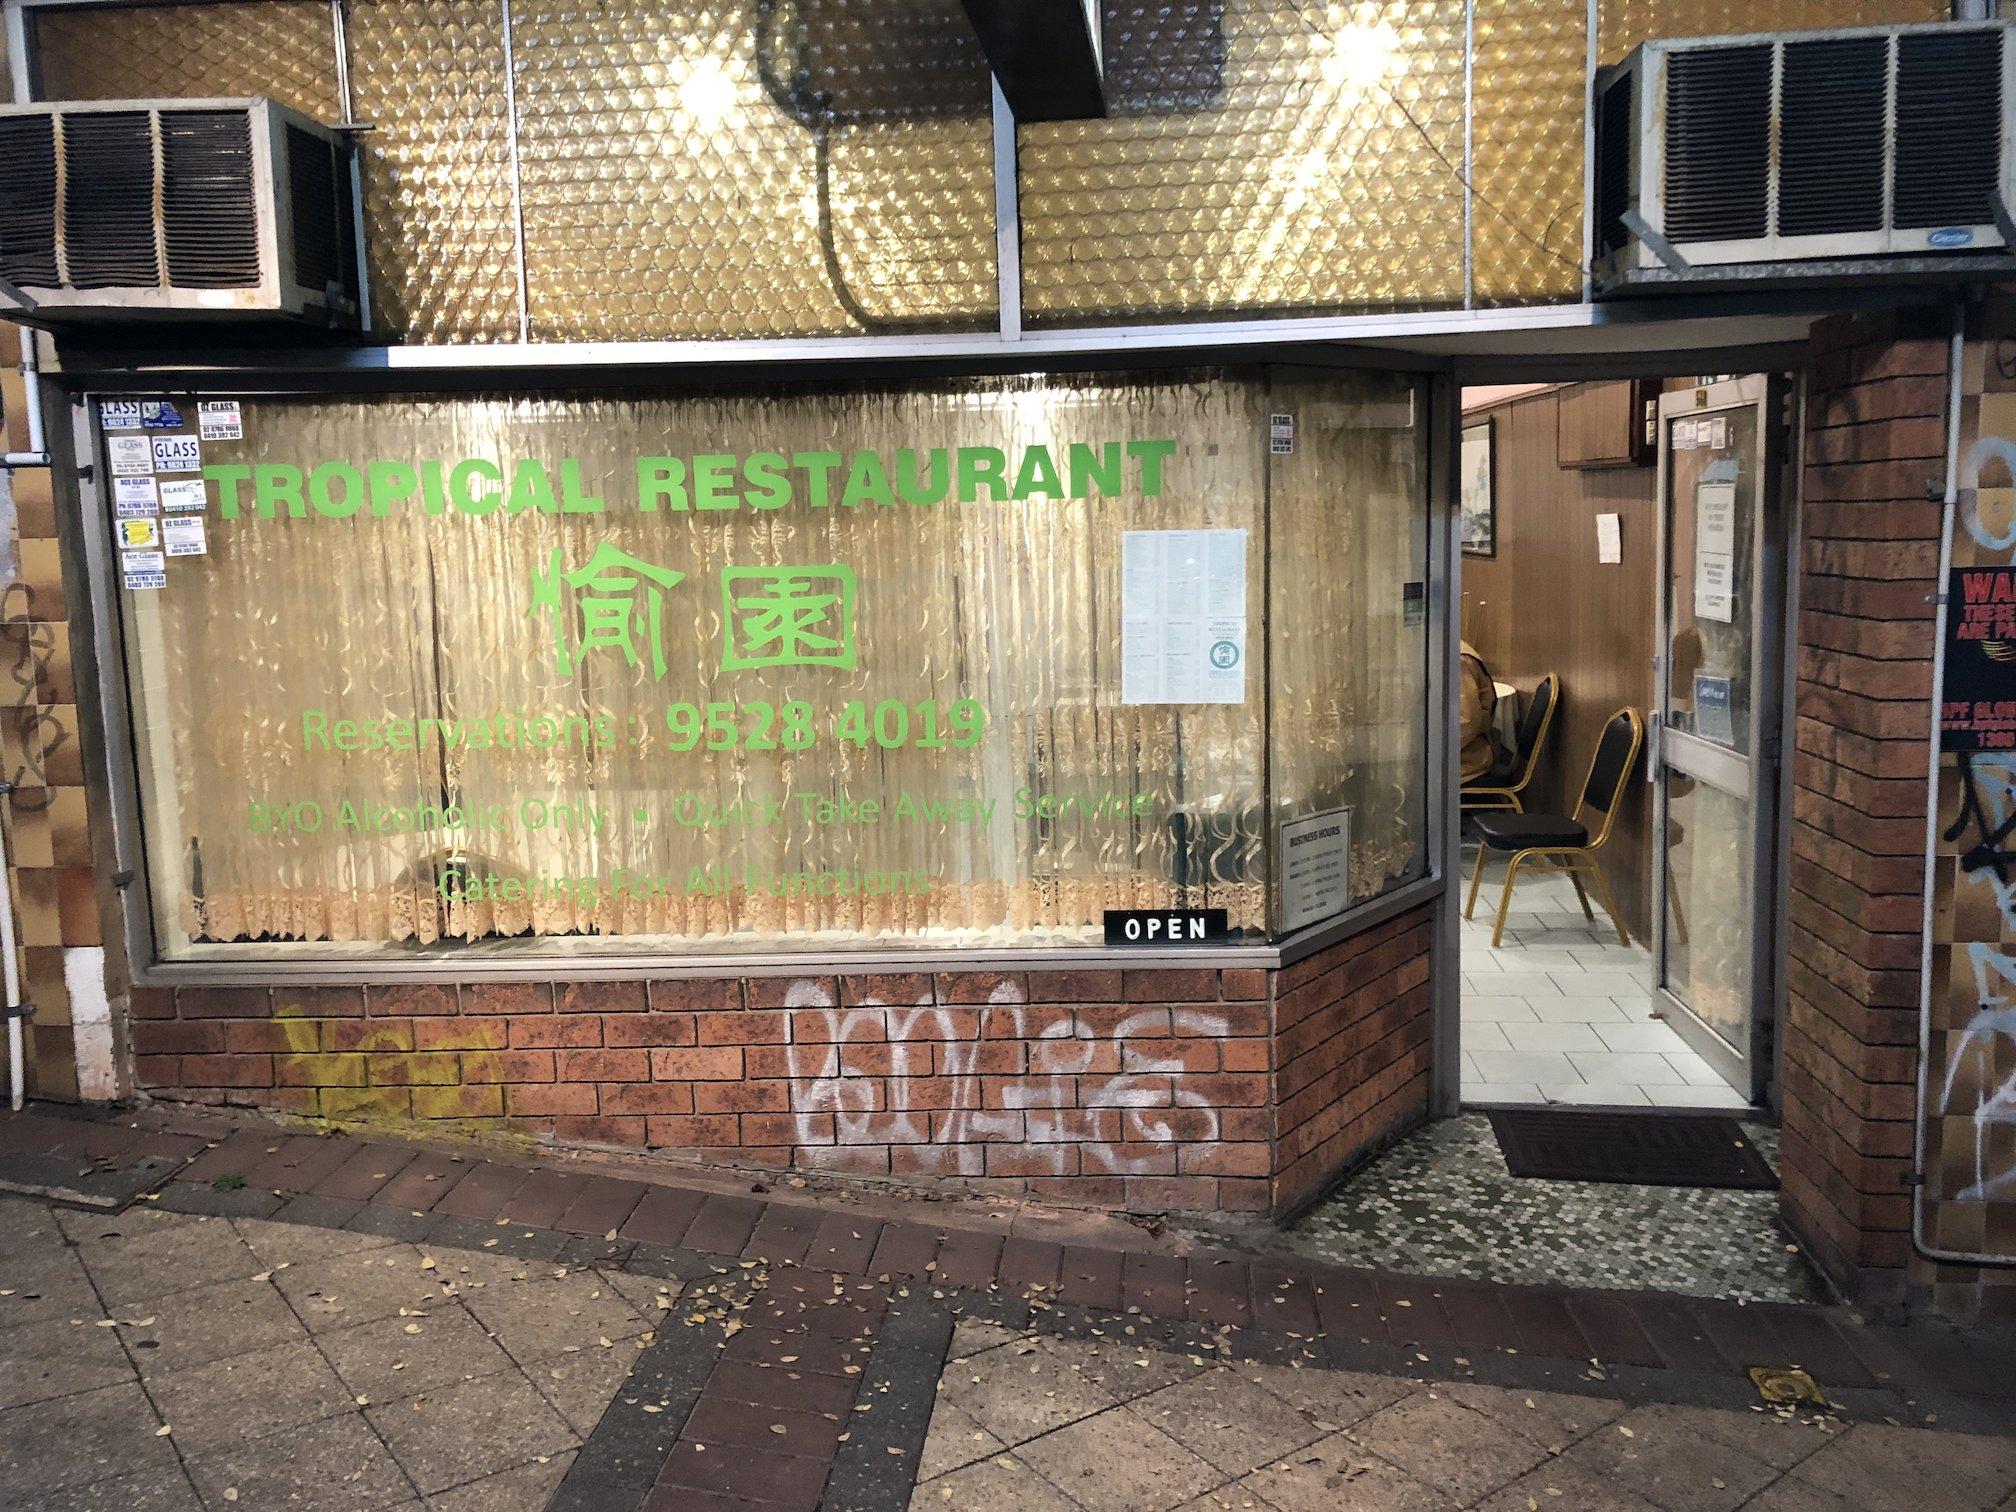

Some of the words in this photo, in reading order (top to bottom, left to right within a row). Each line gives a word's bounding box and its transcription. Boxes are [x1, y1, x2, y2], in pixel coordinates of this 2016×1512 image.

[211, 402, 235, 411] GLASS
[155, 442, 197, 458] GLASS
[132, 478, 151, 486] GLASS
[202, 458, 605, 520] TROPICAL
[636, 440, 1177, 512] RESTAURANT
[173, 519, 192, 527] GLASS
[667, 701, 816, 752] 9528
[836, 697, 985, 750] 4019
[248, 800, 323, 833] BYO
[337, 797, 512, 832] Alcoholic
[520, 791, 605, 837] Only
[675, 792, 782, 828] Quick
[799, 791, 880, 825] Take
[893, 792, 996, 829] Away
[1013, 787, 1155, 822] Service
[1319, 825, 1340, 839] HOURS
[439, 870, 598, 910] Catering
[612, 868, 670, 900] For
[684, 865, 730, 896] All
[747, 863, 931, 896] Functions
[1124, 917, 1206, 940] OPEN
